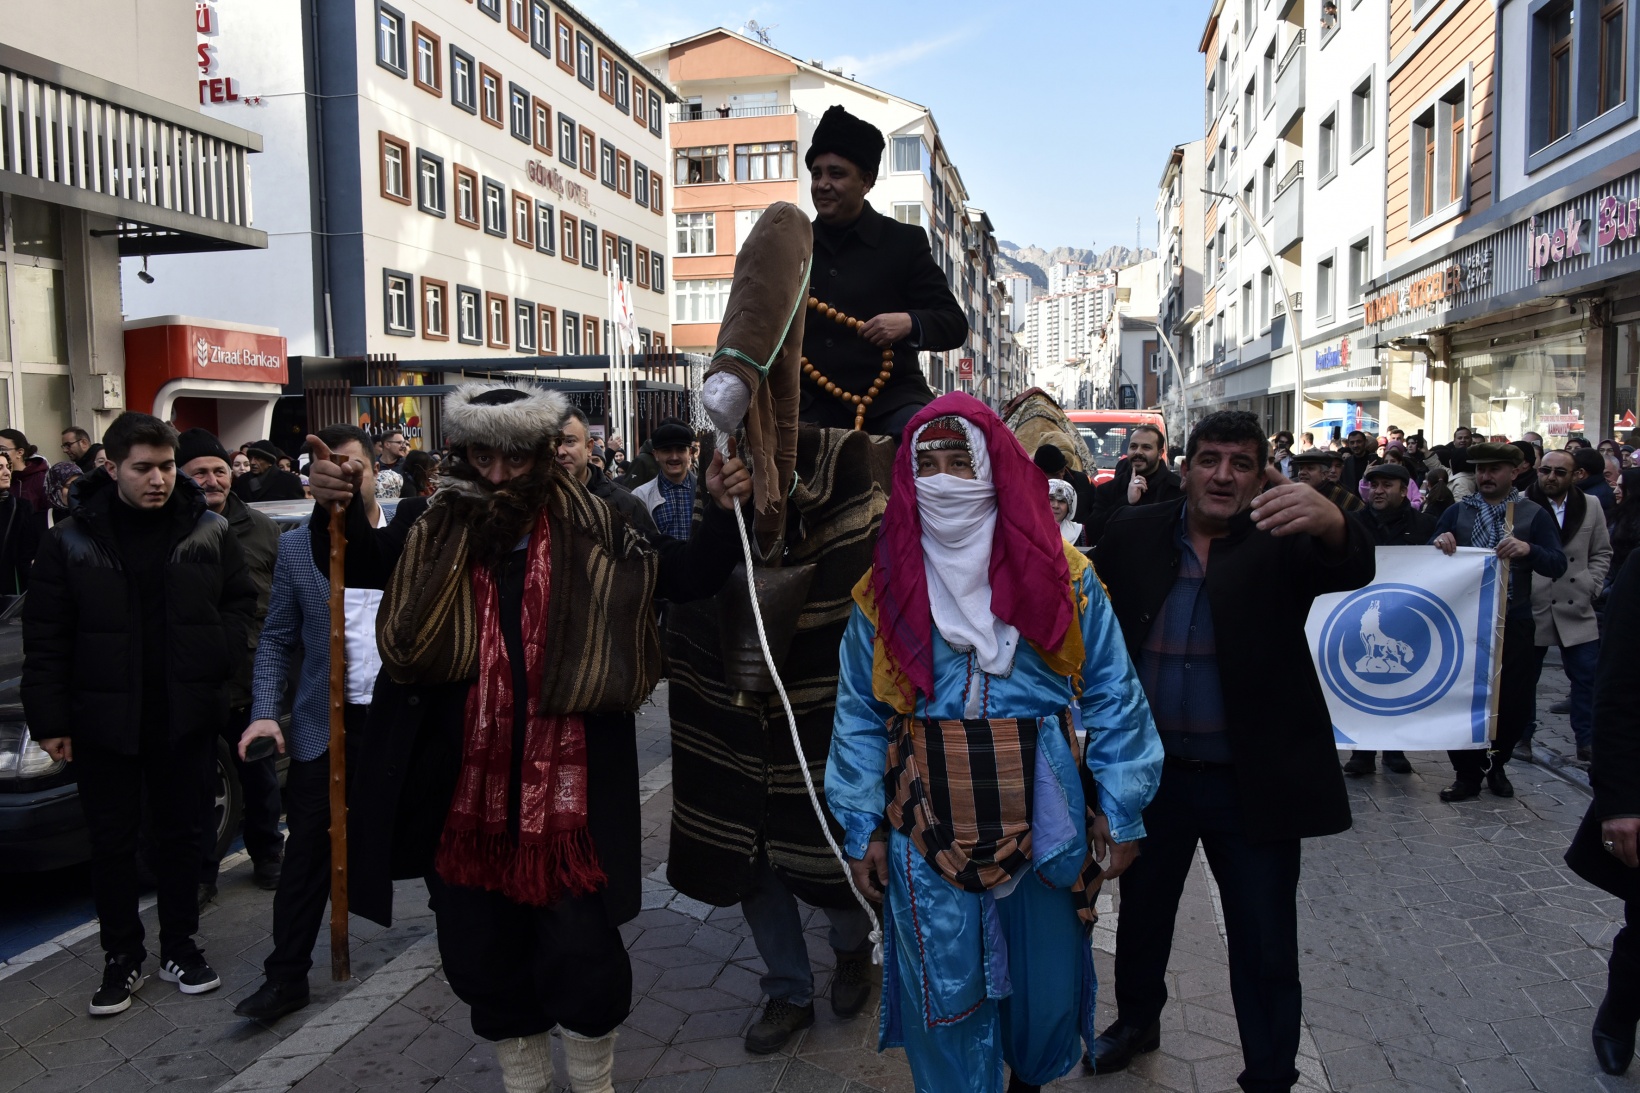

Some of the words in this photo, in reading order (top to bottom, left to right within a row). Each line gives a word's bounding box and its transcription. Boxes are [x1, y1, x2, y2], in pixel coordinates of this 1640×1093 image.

[565, 180, 591, 208] OTEL
[1598, 195, 1640, 248] Bu
[210, 345, 241, 365] Ziraat
[243, 349, 280, 369] Bankası
